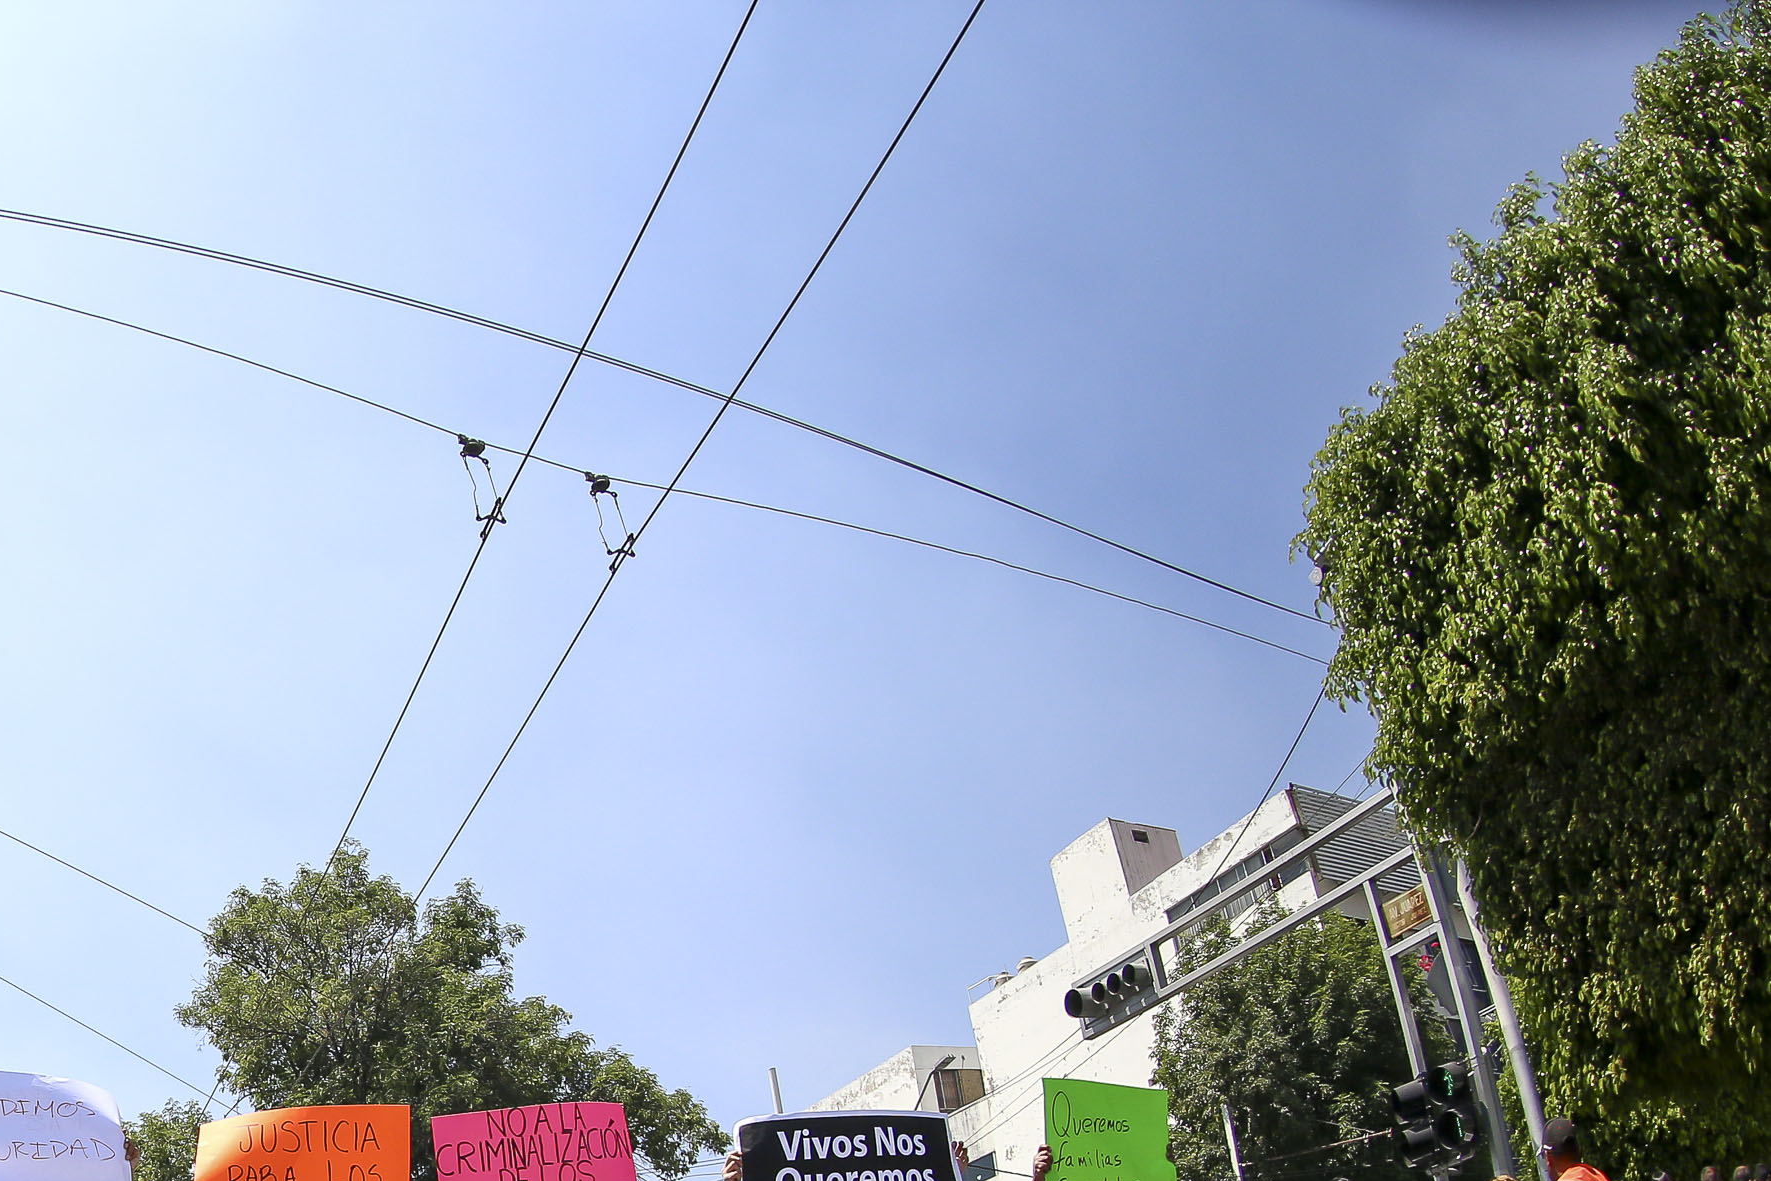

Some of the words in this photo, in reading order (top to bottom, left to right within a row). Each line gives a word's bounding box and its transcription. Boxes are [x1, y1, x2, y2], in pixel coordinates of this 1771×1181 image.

[237, 1120, 380, 1153] JUSTICIA
[486, 1107, 527, 1139] NO
[533, 1105, 553, 1135] A
[558, 1103, 587, 1134] LA
[436, 1118, 632, 1176] CRIMINALIZACIÓN
[777, 1128, 868, 1161] Vivos
[874, 1126, 926, 1157] Nos
[1053, 1141, 1122, 1172] familias
